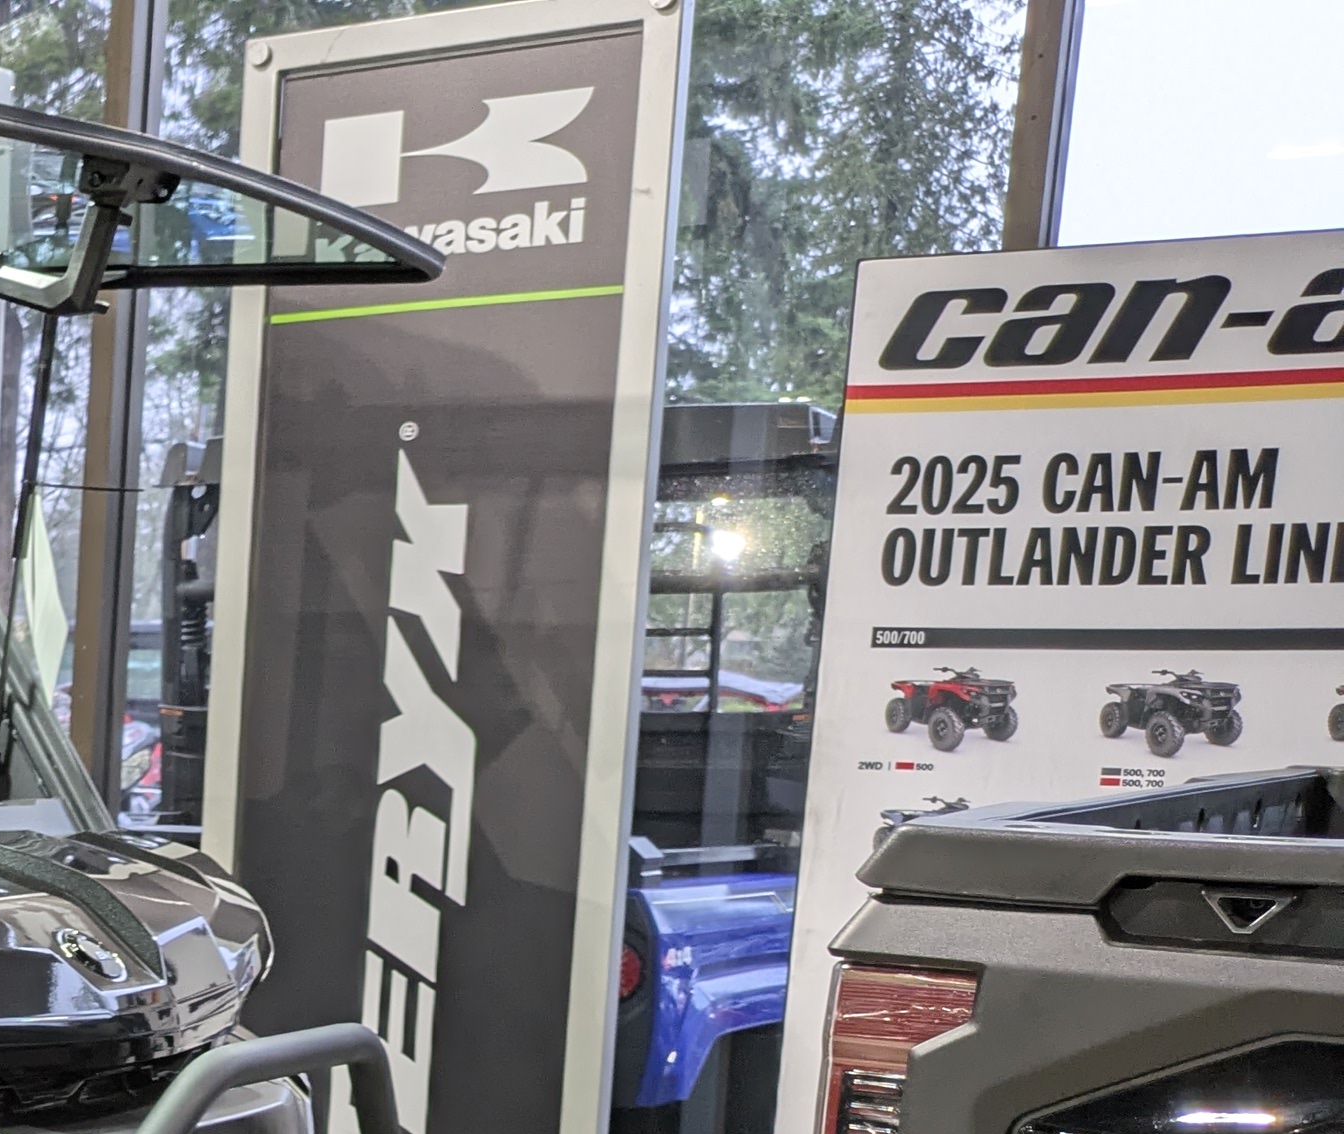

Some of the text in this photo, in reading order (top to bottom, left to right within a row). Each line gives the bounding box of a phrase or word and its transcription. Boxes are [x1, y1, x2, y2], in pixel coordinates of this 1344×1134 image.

[885, 447, 1280, 516] 2025 CAN-AM
[880, 524, 1213, 588] OUTLANDER
[875, 629, 926, 647] 500/700
[857, 761, 934, 772] 2WD 500
[1123, 768, 1166, 779] 500, 700
[1121, 779, 1165, 789] 500, 700
